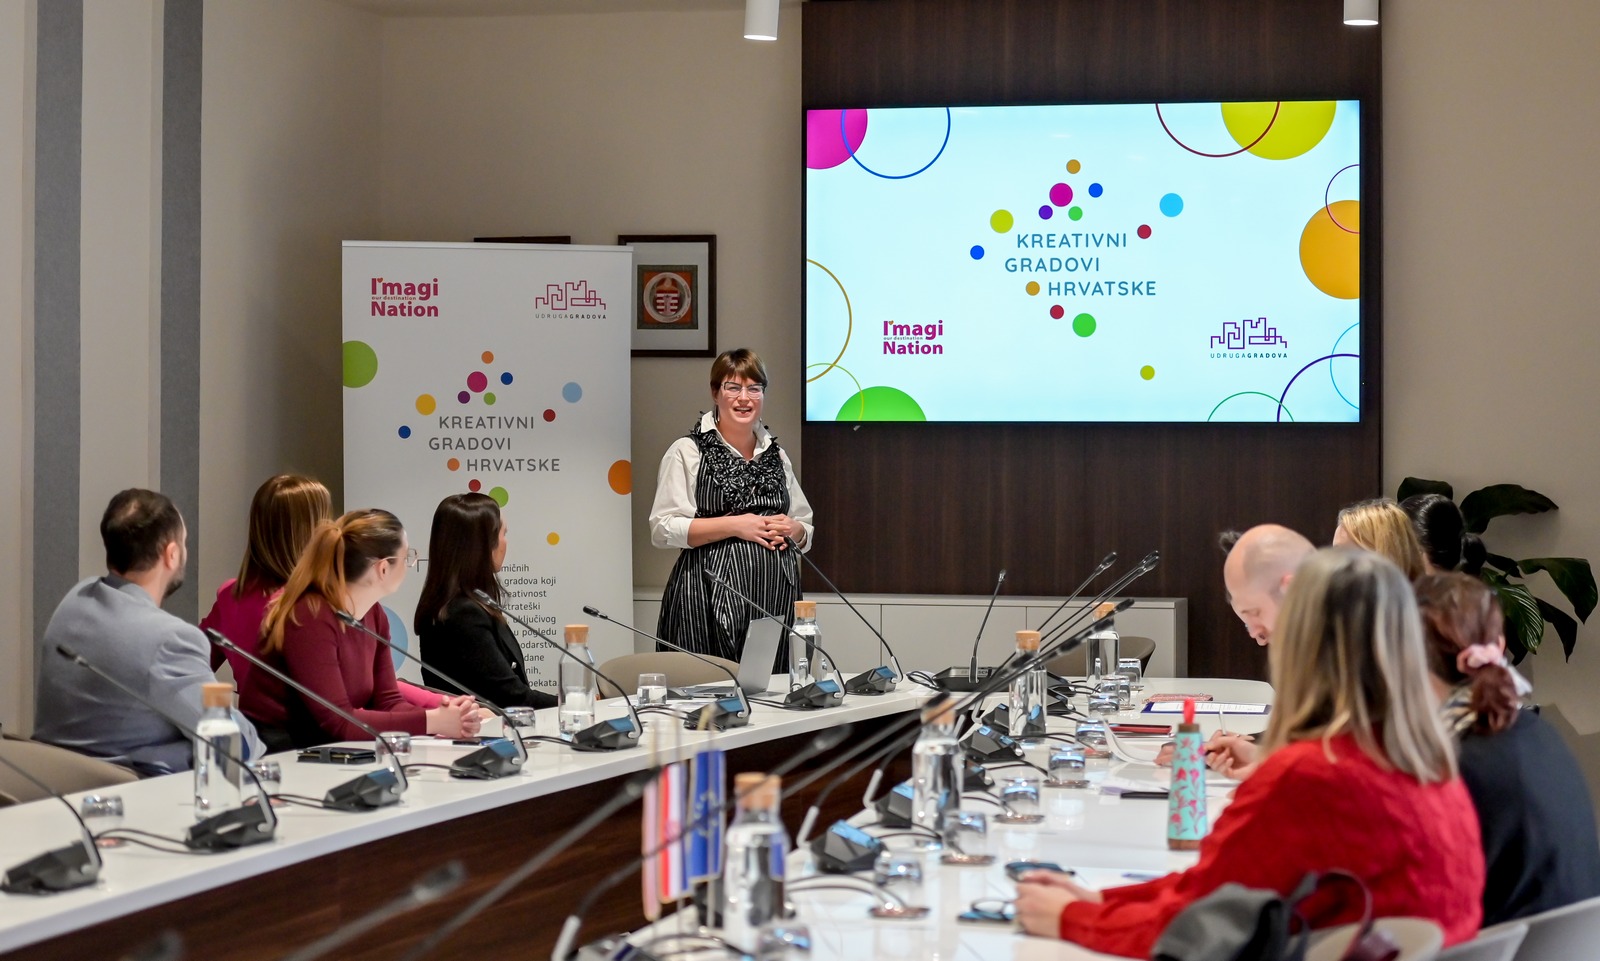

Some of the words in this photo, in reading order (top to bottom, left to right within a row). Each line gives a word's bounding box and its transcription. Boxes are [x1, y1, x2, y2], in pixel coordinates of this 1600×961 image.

[1016, 233, 1127, 248] KREATIVNI
[1004, 257, 1100, 273] GRADOVI
[1048, 281, 1157, 296] HRVATSKE
[371, 301, 439, 317] Nation
[883, 340, 944, 355] Nation
[438, 416, 534, 430] KREATIVNI
[428, 437, 512, 451] GRADOVI
[466, 458, 561, 472] HRVATSKE
[501, 563, 530, 573] mičnih
[504, 576, 538, 588] gradova
[541, 576, 557, 587] koji
[520, 641, 559, 649] odarstva
[524, 653, 545, 662] dane
